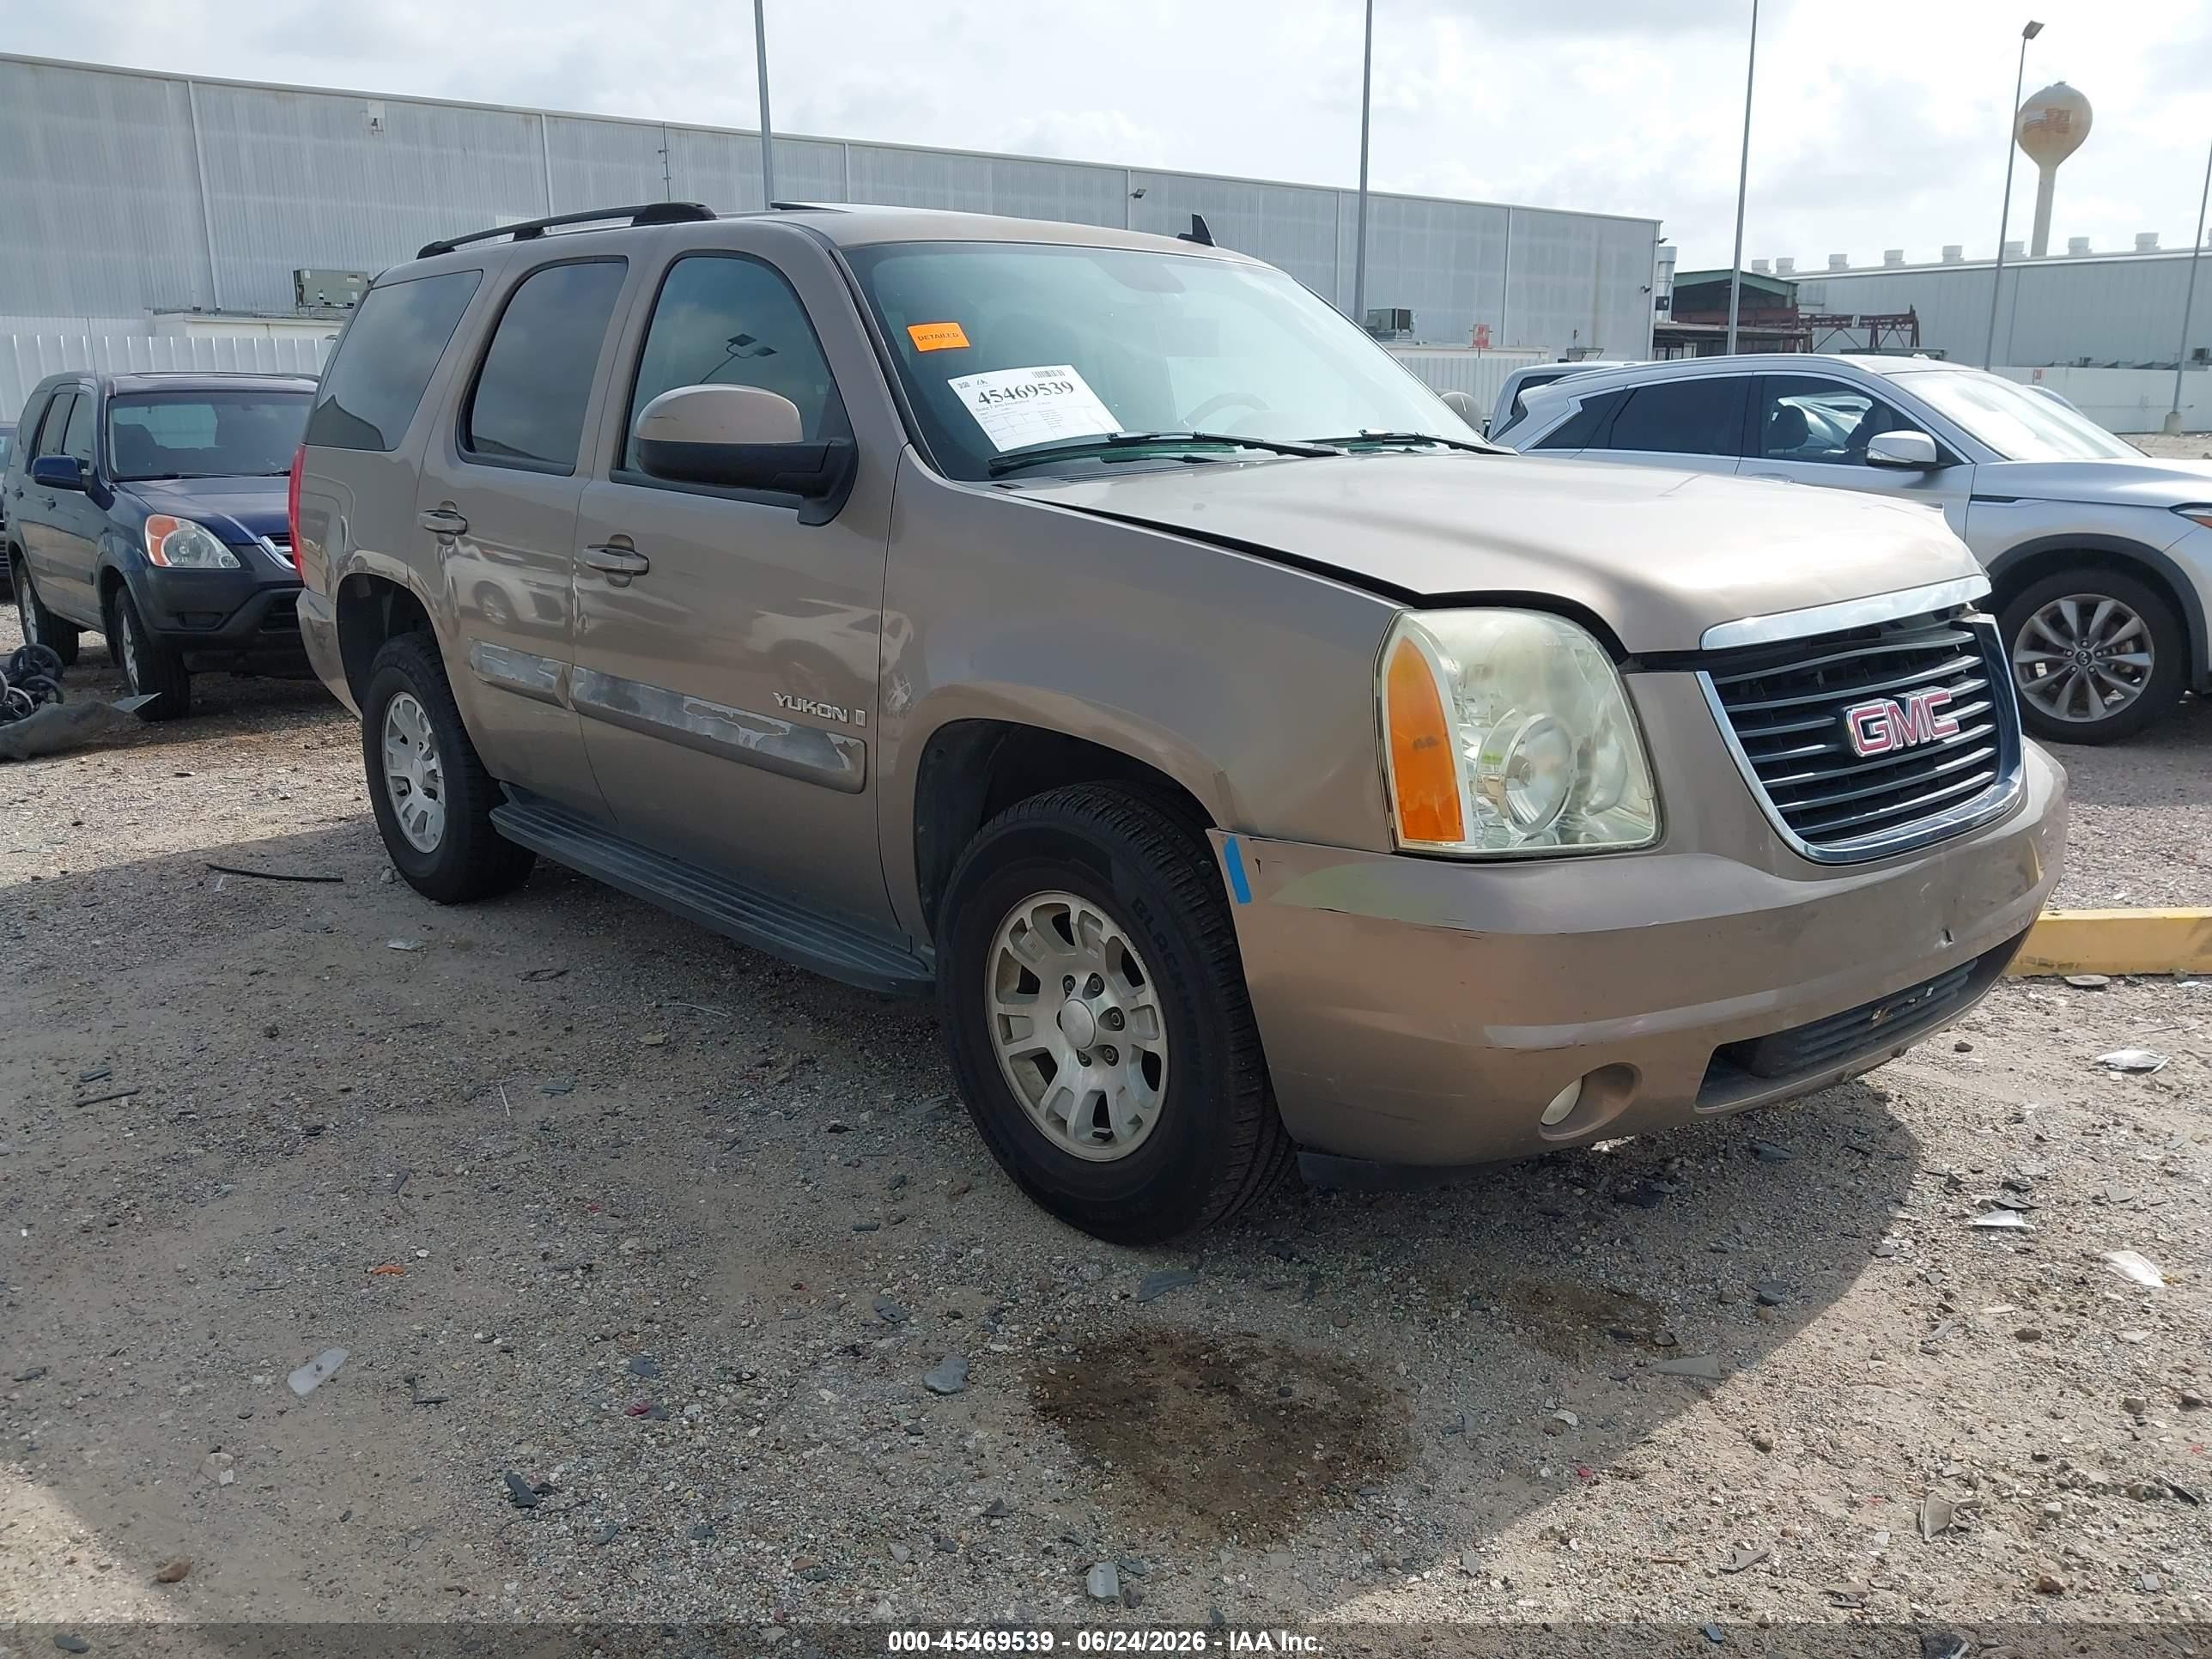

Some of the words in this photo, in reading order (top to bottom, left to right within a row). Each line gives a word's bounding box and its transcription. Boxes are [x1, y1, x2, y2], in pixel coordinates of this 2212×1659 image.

[917, 331, 959, 342] DETAILED
[977, 380, 1074, 404] 45469539
[773, 692, 849, 723] YUKON
[1846, 689, 1960, 757] GMC
